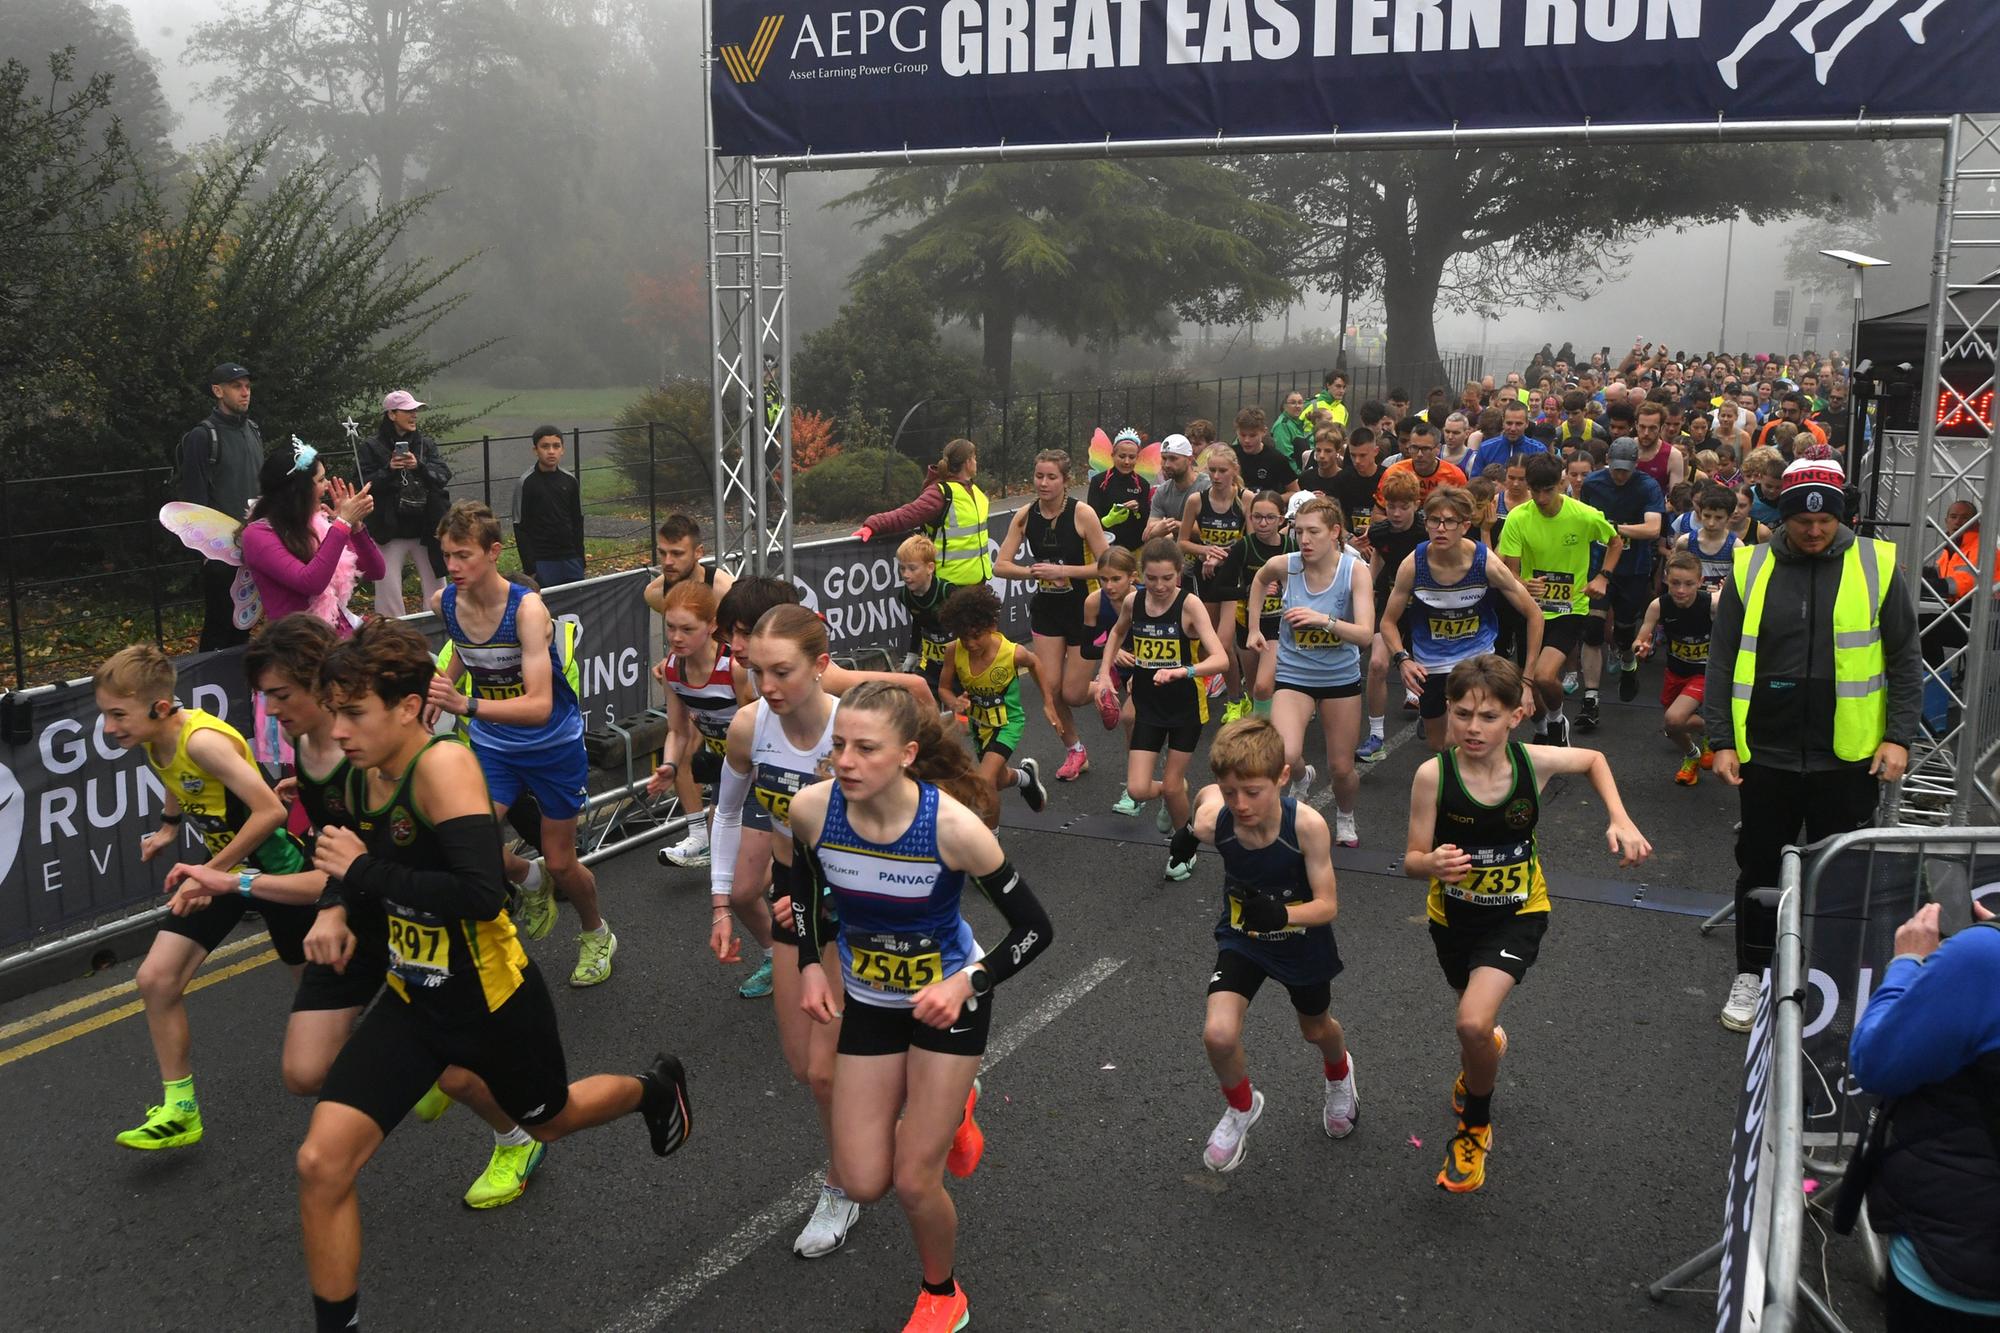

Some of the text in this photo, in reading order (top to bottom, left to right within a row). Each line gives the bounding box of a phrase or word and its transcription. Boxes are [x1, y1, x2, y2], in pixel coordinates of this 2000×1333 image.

[790, 5, 927, 59] AEPG
[940, 0, 1702, 77] GREAT EASTERN RUN
[788, 62, 929, 80] Asset Earning Power Group
[1543, 583, 1571, 600] 228
[1431, 618, 1476, 635] 7477
[1134, 639, 1177, 660] 7325
[879, 871, 935, 886] PANVAC
[1470, 866, 1522, 895] 735
[1474, 895, 1520, 905] RUNNING
[856, 952, 934, 989] 7545
